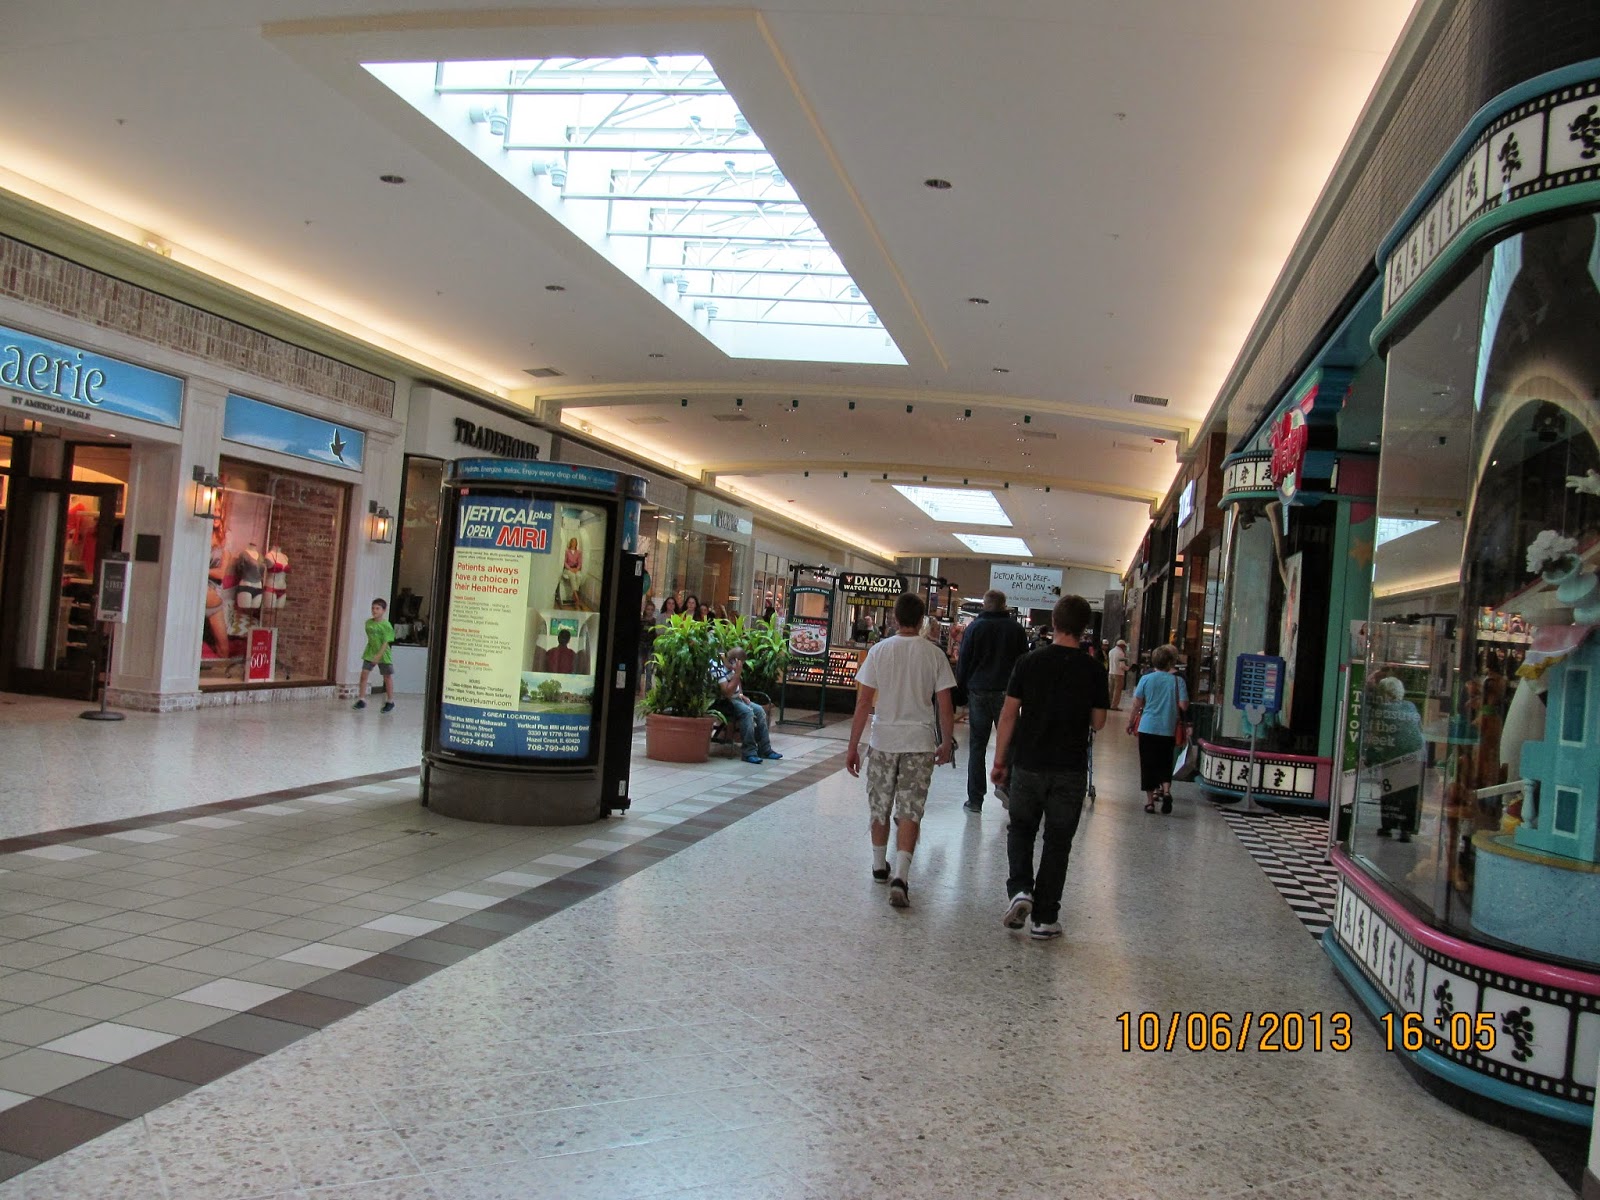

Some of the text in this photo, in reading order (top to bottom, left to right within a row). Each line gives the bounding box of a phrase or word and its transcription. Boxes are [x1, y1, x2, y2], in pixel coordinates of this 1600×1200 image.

[0, 344, 106, 405] aerie
[24, 399, 65, 414] AMERICAN
[66, 406, 90, 420] EAGLE
[522, 468, 538, 476] Enjoy
[538, 470, 556, 478] every
[556, 471, 571, 480] drop
[459, 505, 552, 539] VERTICAL plus
[466, 524, 547, 550] OPEN MRI
[457, 562, 519, 575] Patients always
[455, 572, 471, 581] have
[479, 575, 508, 584] choice
[511, 577, 519, 585] in
[854, 575, 902, 588] DAKOTA
[1011, 581, 1023, 589] EAT
[454, 582, 518, 595] their Healthcare
[843, 584, 903, 594] WATCH COMPANY
[480, 719, 507, 727] Mishawaka
[506, 713, 540, 721] LOCATIONS
[449, 735, 494, 747] 574-257-4674
[527, 744, 579, 752] 708-799-4940
